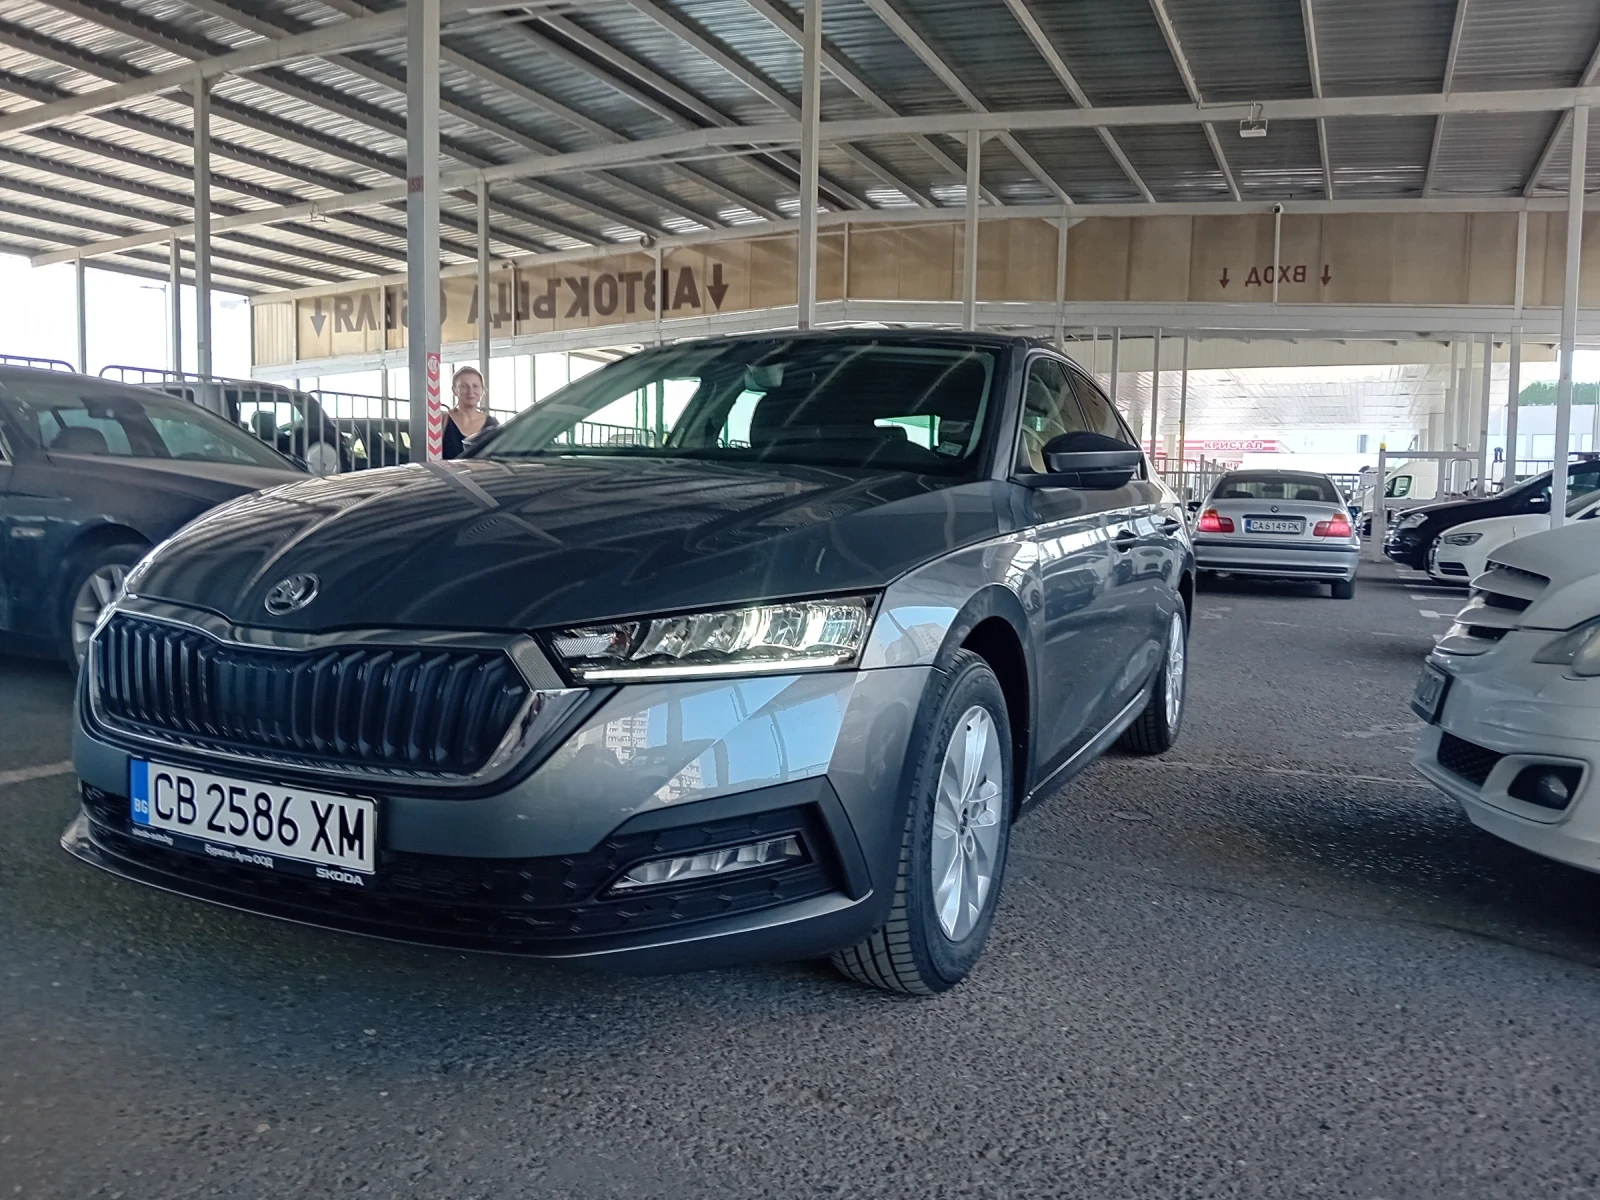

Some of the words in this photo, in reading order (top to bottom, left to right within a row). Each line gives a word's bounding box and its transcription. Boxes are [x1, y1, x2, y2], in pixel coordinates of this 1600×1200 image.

[1203, 441, 1263, 450] КРИСТАЛ
[134, 797, 149, 815] BG
[154, 772, 198, 825] CB
[206, 783, 299, 847] 2586
[310, 800, 365, 861] XM
